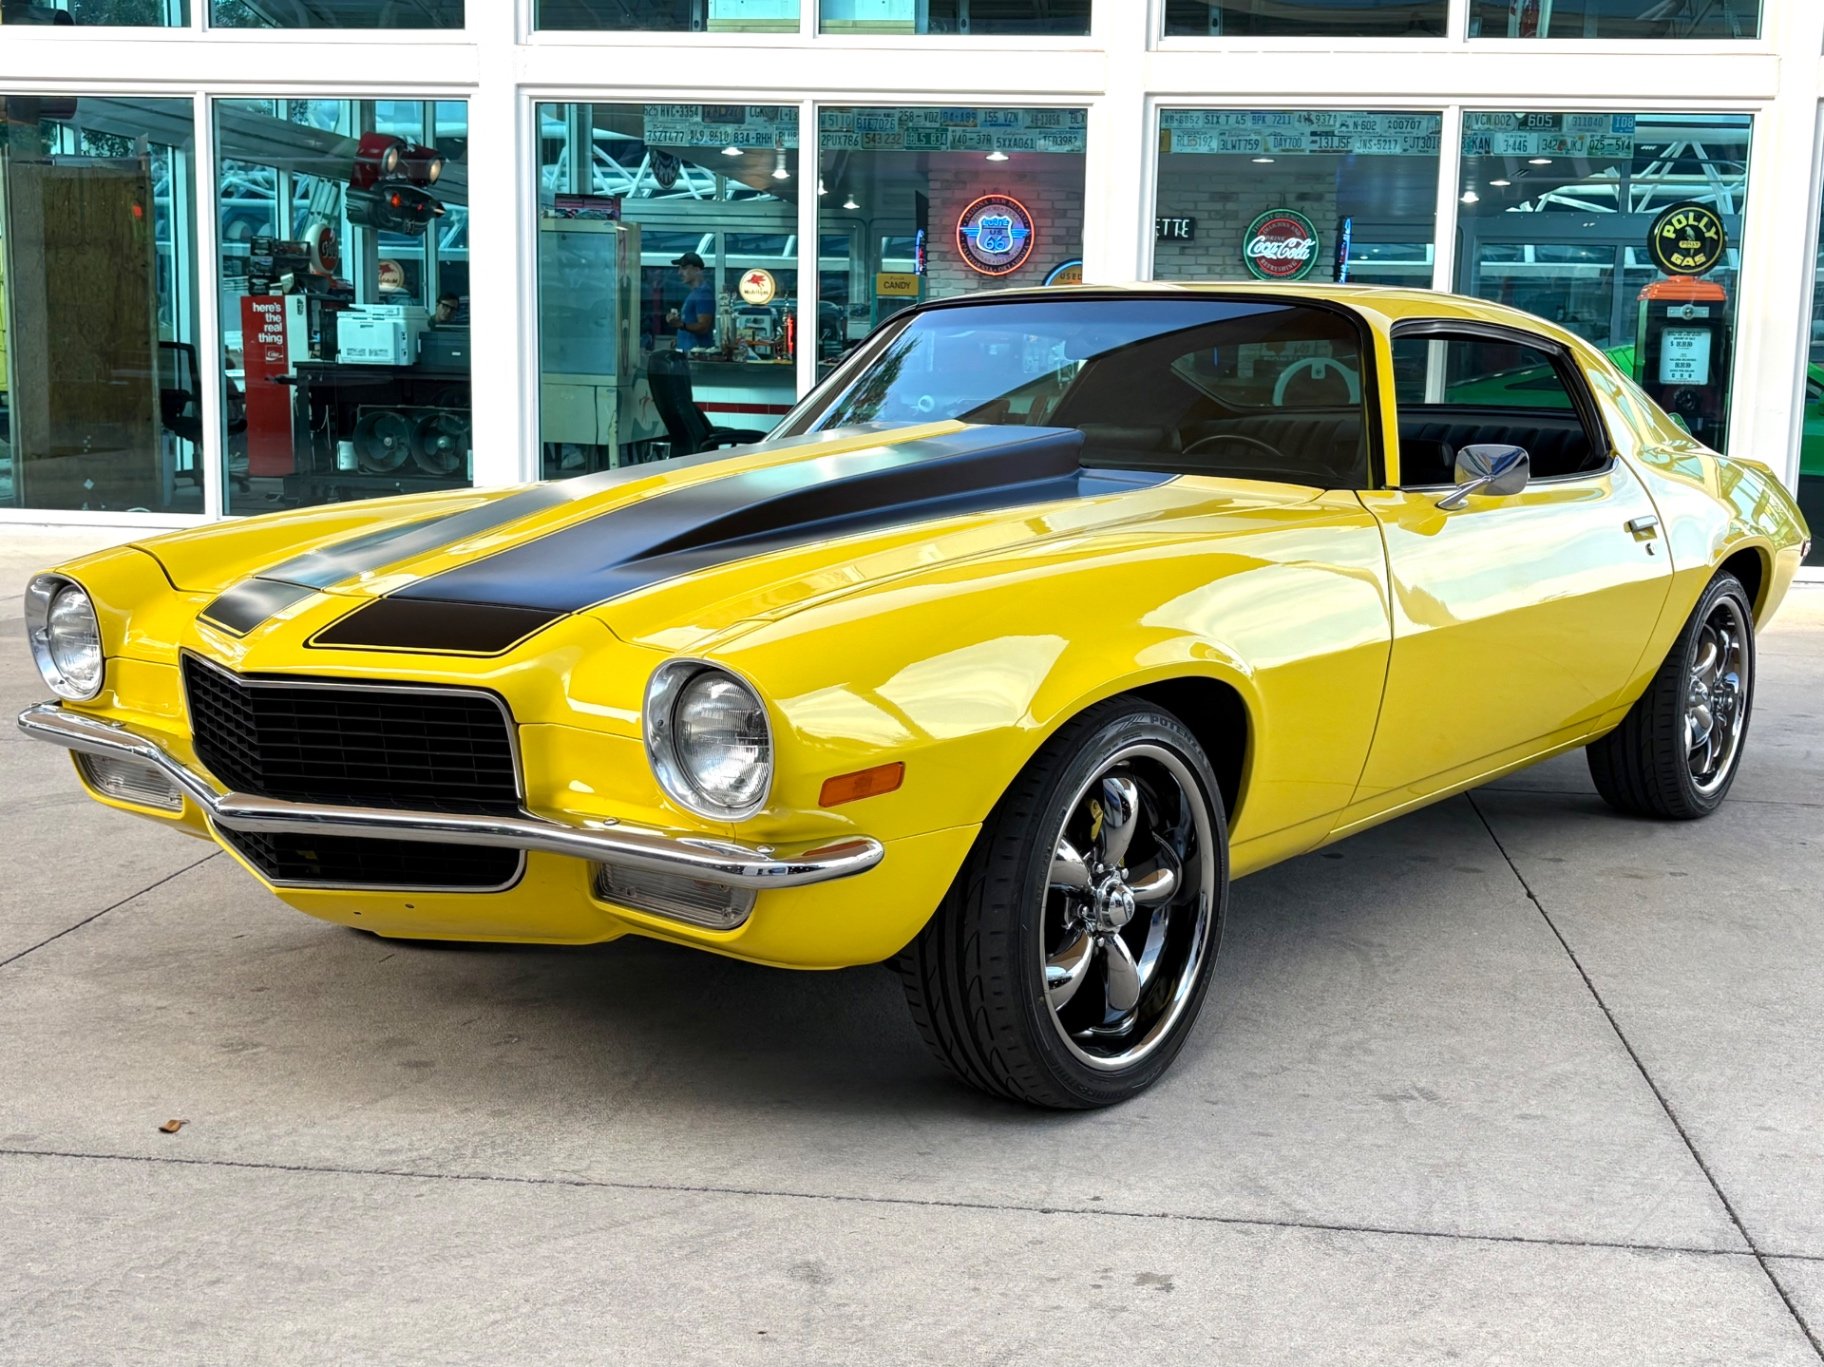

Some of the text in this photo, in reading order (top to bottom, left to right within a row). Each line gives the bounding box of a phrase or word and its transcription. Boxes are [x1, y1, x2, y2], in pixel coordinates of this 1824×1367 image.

[1220, 138, 1260, 151] 3LWT759
[1662, 212, 1718, 240] POLLY
[983, 235, 1005, 250] 66
[1247, 235, 1316, 260] Coca-Cola
[1671, 253, 1706, 266] GAS
[883, 281, 911, 289] CANDY
[252, 302, 282, 312] here's
[265, 312, 282, 322] the
[263, 322, 283, 332] real
[258, 333, 283, 344] thing
